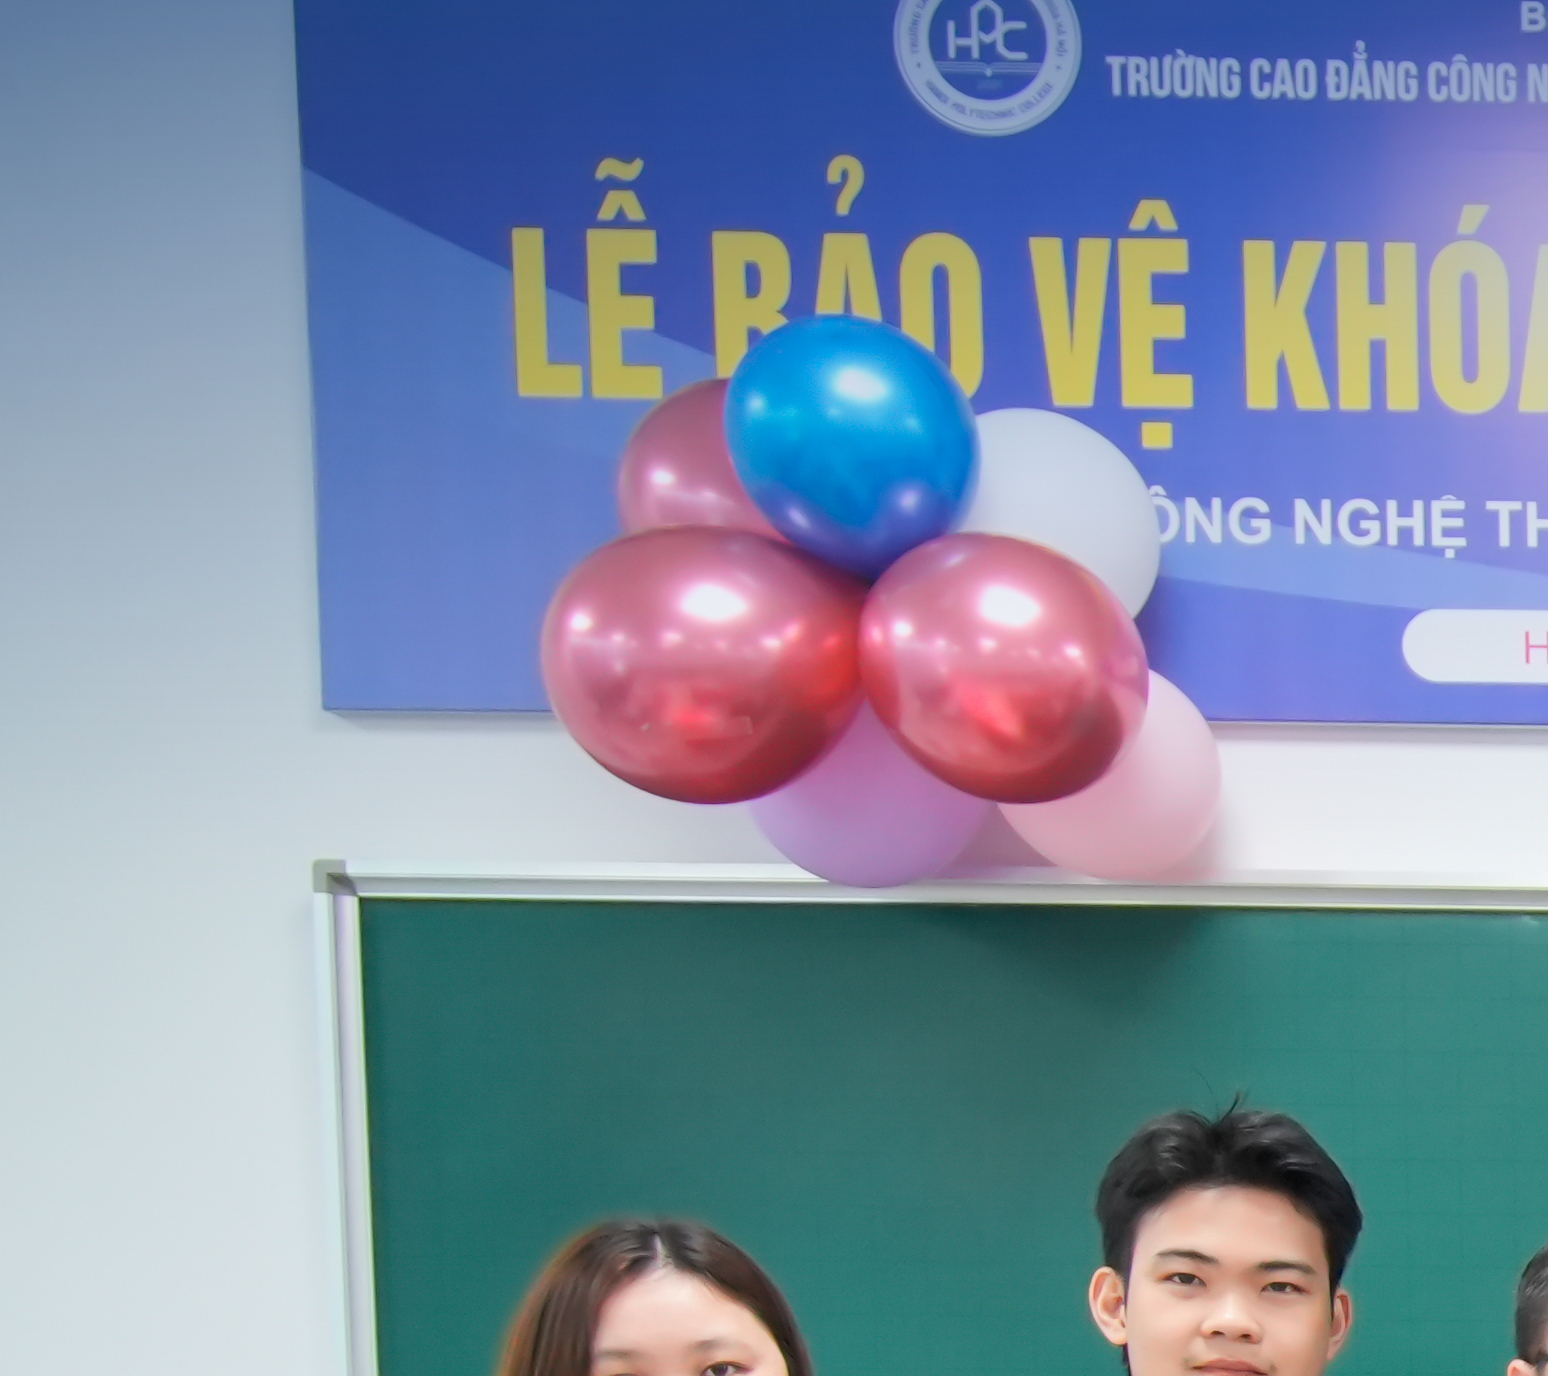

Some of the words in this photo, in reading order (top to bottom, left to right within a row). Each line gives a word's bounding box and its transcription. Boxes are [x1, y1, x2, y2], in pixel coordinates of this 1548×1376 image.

[1106, 49, 1240, 99] TRƯỜNG
[1251, 58, 1317, 99] CAO
[1325, 40, 1418, 101] ĐẲNG
[1428, 53, 1516, 103] CÔNG
[511, 157, 663, 398] LỄ
[1028, 199, 1194, 449] VỆ
[1151, 485, 1271, 545] ÔNG
[1295, 494, 1466, 558] NGHỆ
